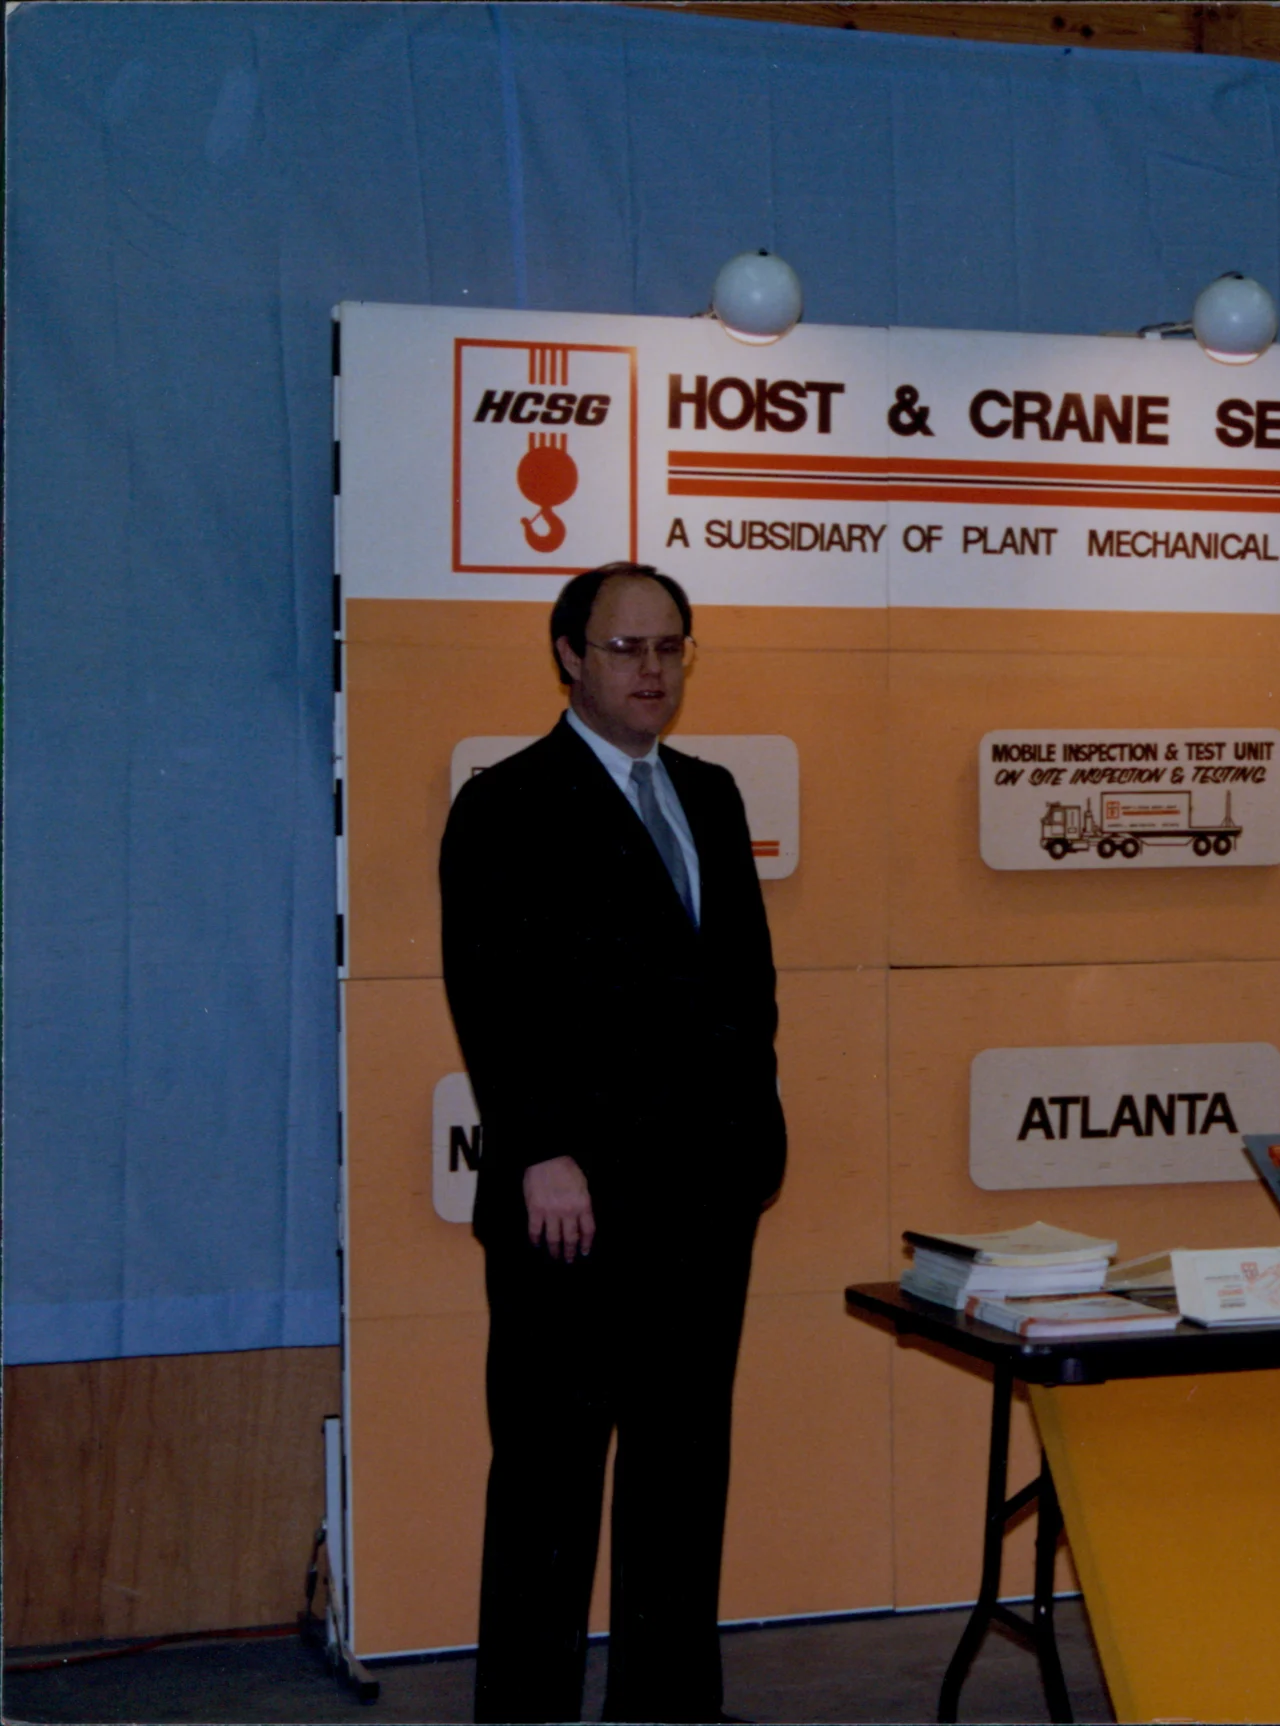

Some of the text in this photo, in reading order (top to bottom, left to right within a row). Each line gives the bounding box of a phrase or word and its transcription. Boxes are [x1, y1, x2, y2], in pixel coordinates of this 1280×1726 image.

[473, 389, 611, 426] HCSG
[667, 374, 846, 434] HOIST
[886, 384, 936, 437] &
[968, 388, 1170, 445] CRANE
[666, 517, 691, 549] A
[704, 518, 888, 554] SUBSIDIARY
[902, 524, 944, 554] OF
[962, 525, 1059, 557] PLANT
[1087, 529, 1280, 563] MECHANICAL
[991, 740, 1275, 763] MOBILE INSPECTION & TEST UNIT
[994, 766, 1266, 787] ON SITE INSPECTION & TESTING
[1017, 1091, 1239, 1142] ATLANTA
